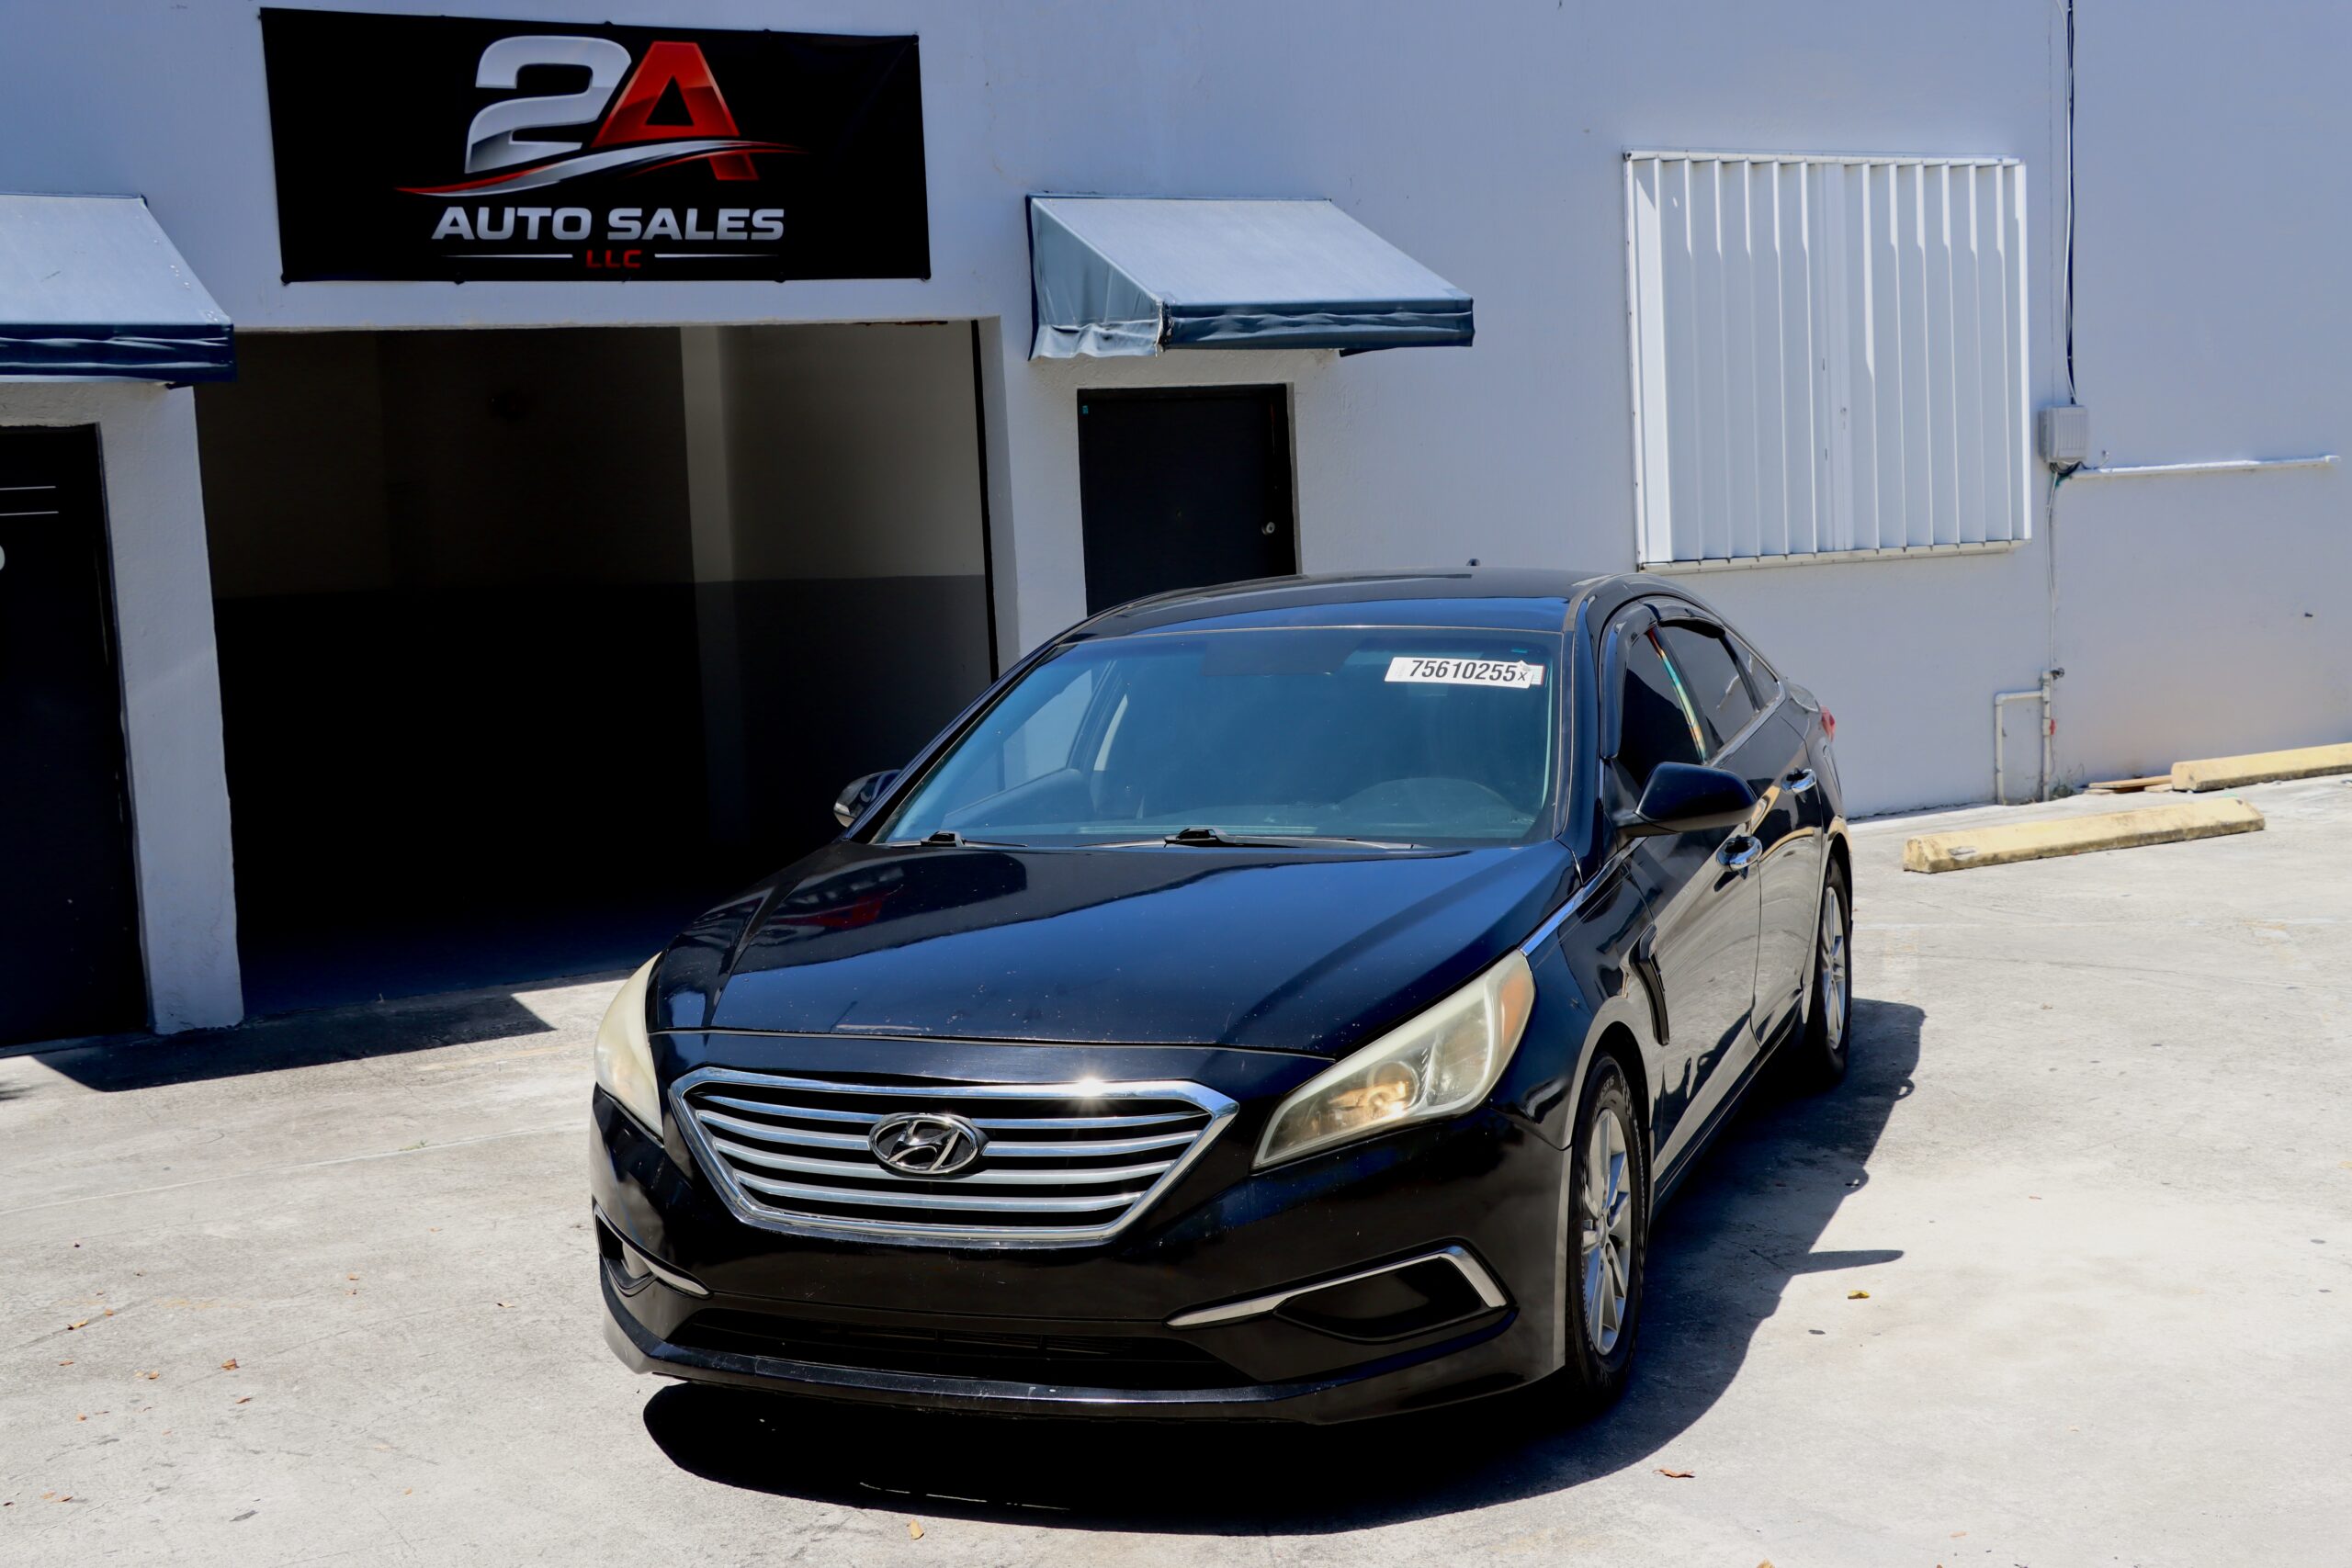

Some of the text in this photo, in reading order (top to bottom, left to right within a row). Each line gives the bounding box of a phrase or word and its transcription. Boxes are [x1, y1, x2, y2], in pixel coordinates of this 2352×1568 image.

[464, 35, 760, 181] 2A
[431, 206, 785, 241] AUTO SALES
[586, 250, 641, 268] LLC
